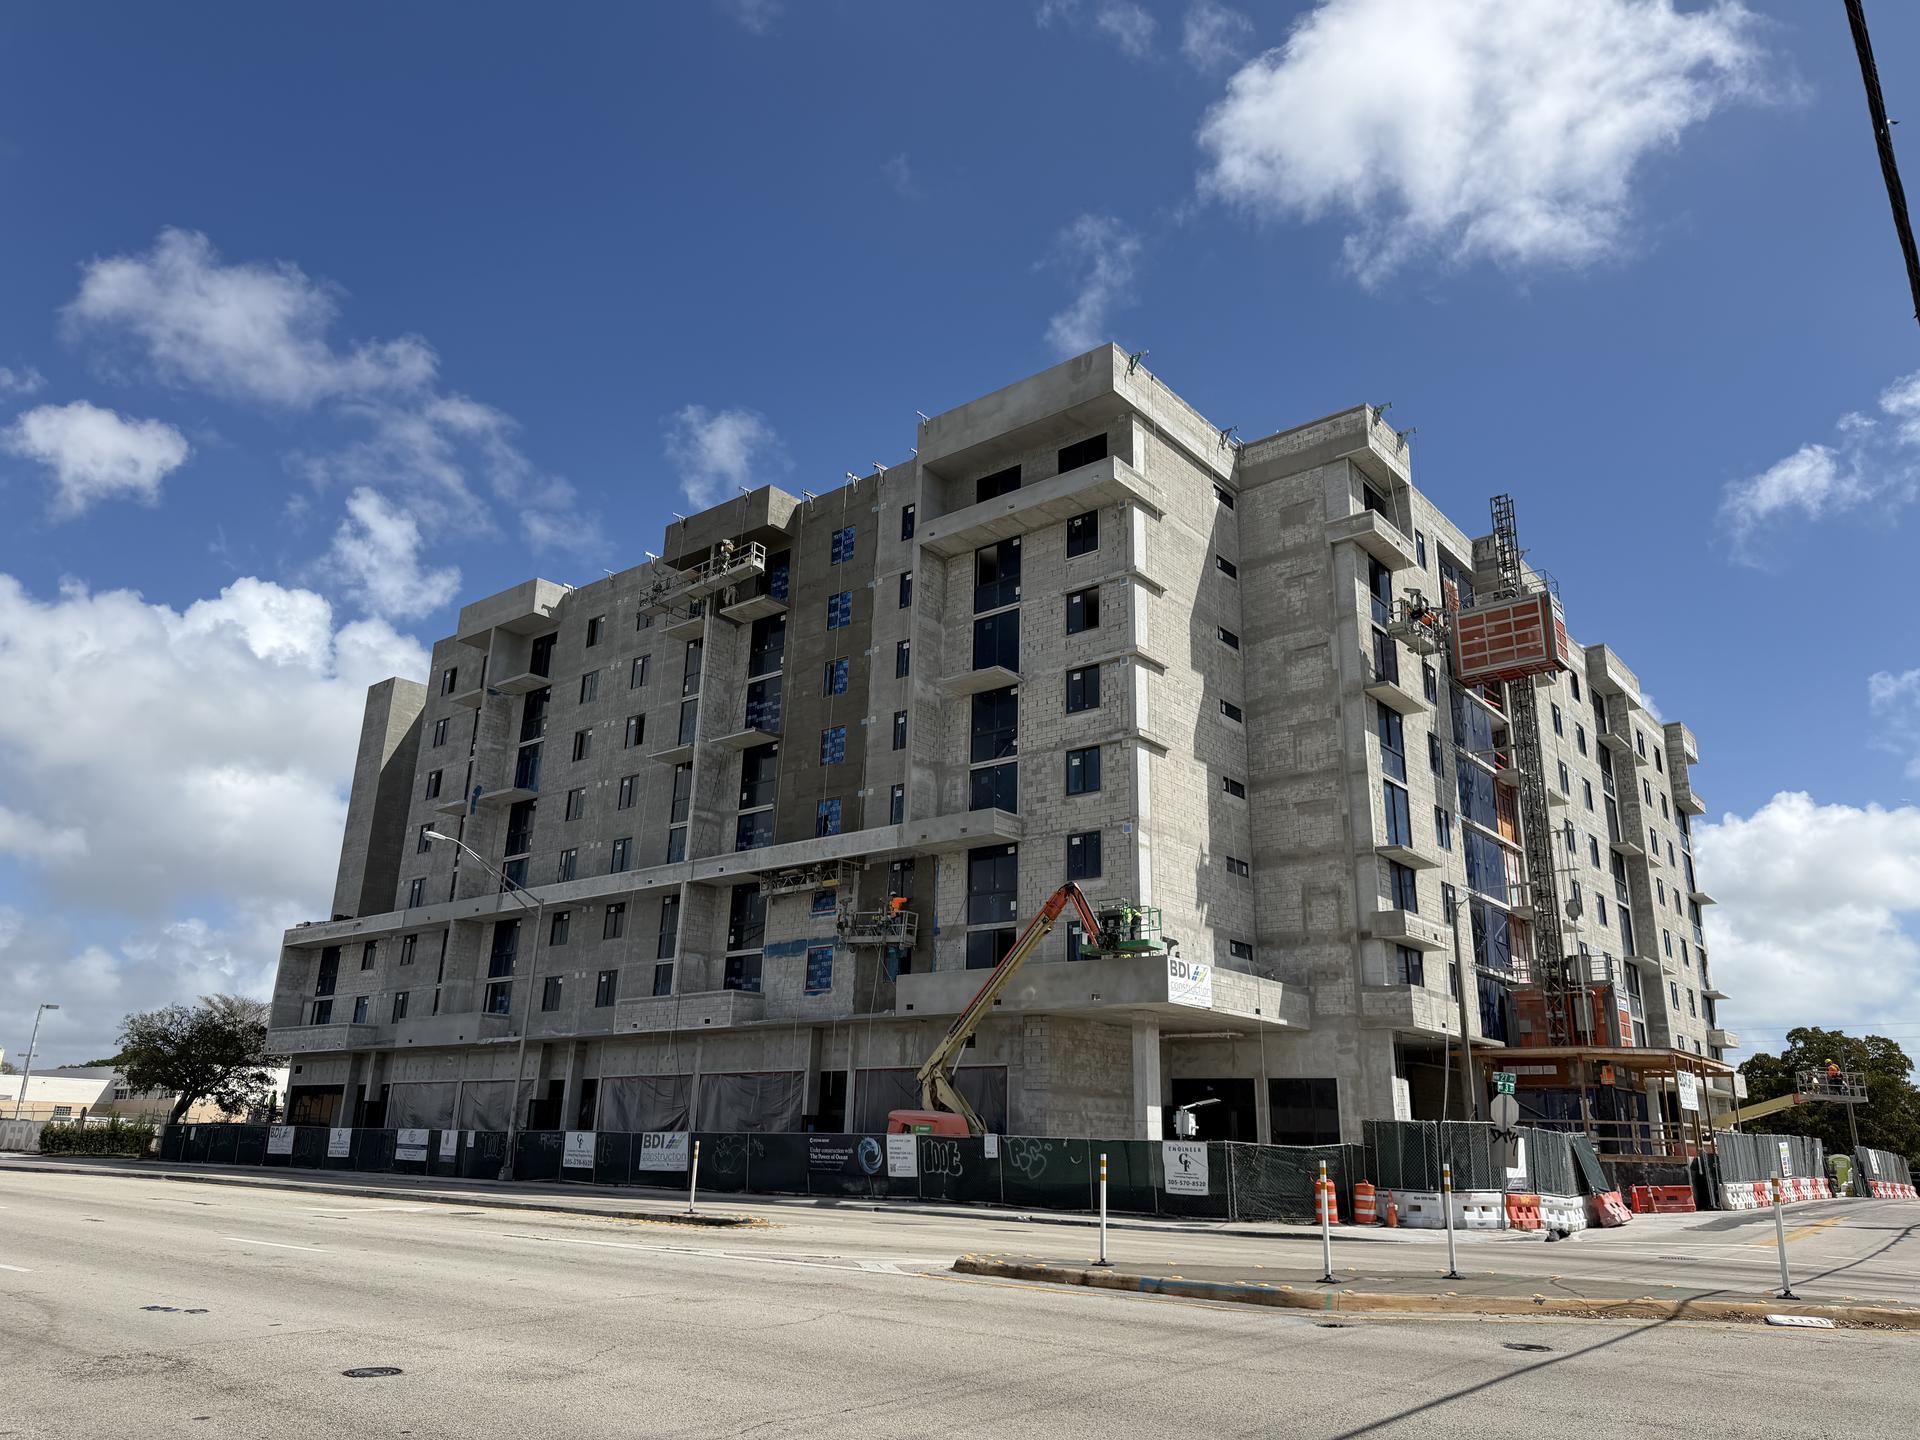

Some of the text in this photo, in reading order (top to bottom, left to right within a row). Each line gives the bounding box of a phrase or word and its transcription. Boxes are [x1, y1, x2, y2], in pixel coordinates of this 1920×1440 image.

[1169, 959, 1190, 980] BDI
[1500, 1073, 1508, 1081] 27
[270, 1127, 283, 1138] BDI
[643, 1134, 665, 1149] BDI
[641, 1152, 687, 1161] construction
